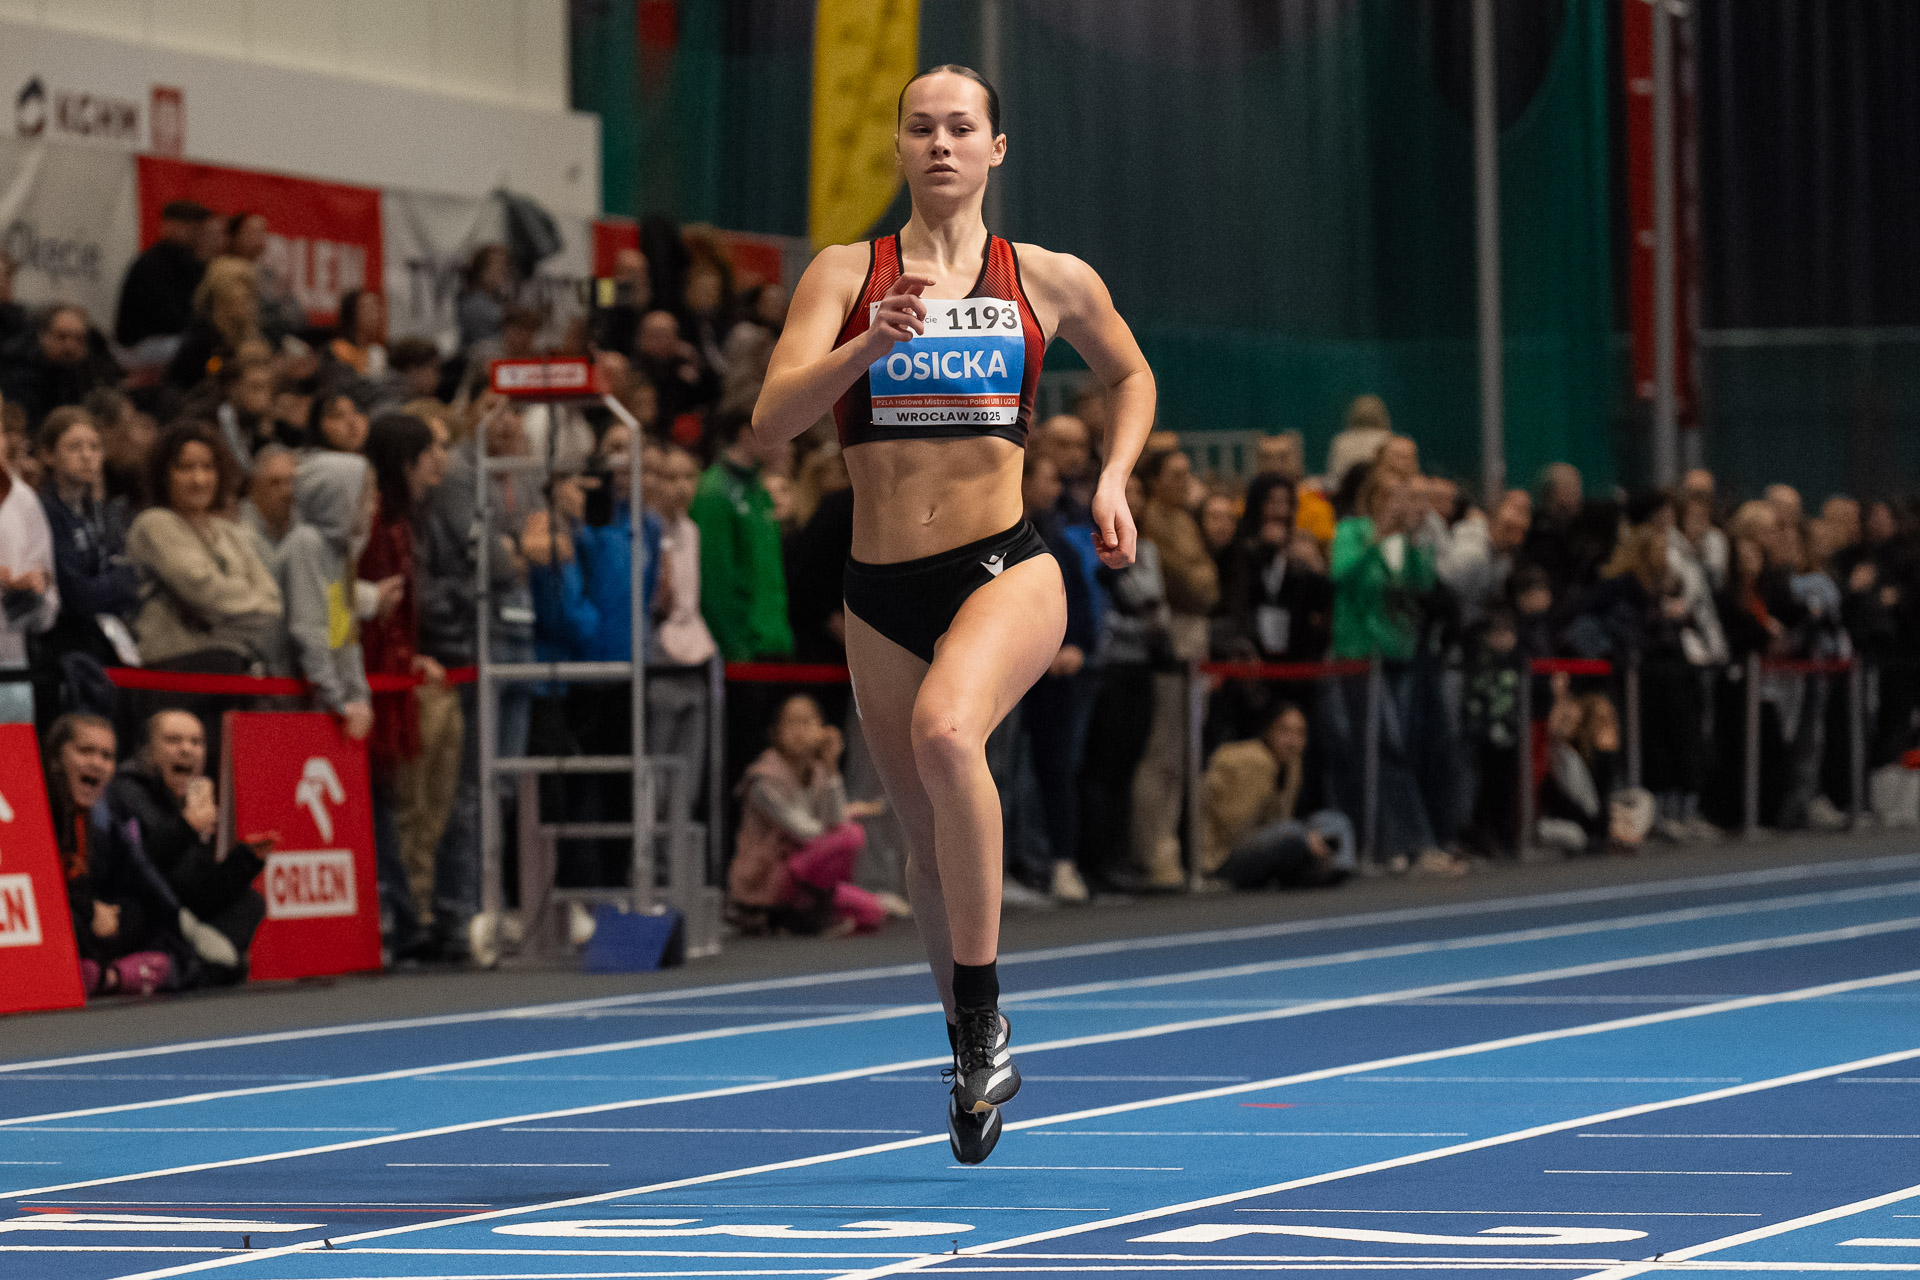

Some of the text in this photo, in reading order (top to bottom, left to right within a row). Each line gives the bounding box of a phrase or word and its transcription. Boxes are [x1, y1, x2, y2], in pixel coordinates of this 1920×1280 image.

[922, 305, 1018, 330] cie 1193
[886, 350, 1008, 381] OSICKA
[924, 398, 968, 406] Mistrzostwa
[969, 398, 990, 406] Polski
[896, 411, 1001, 422] WROCŁAW 2025
[273, 863, 347, 906] ORLEN
